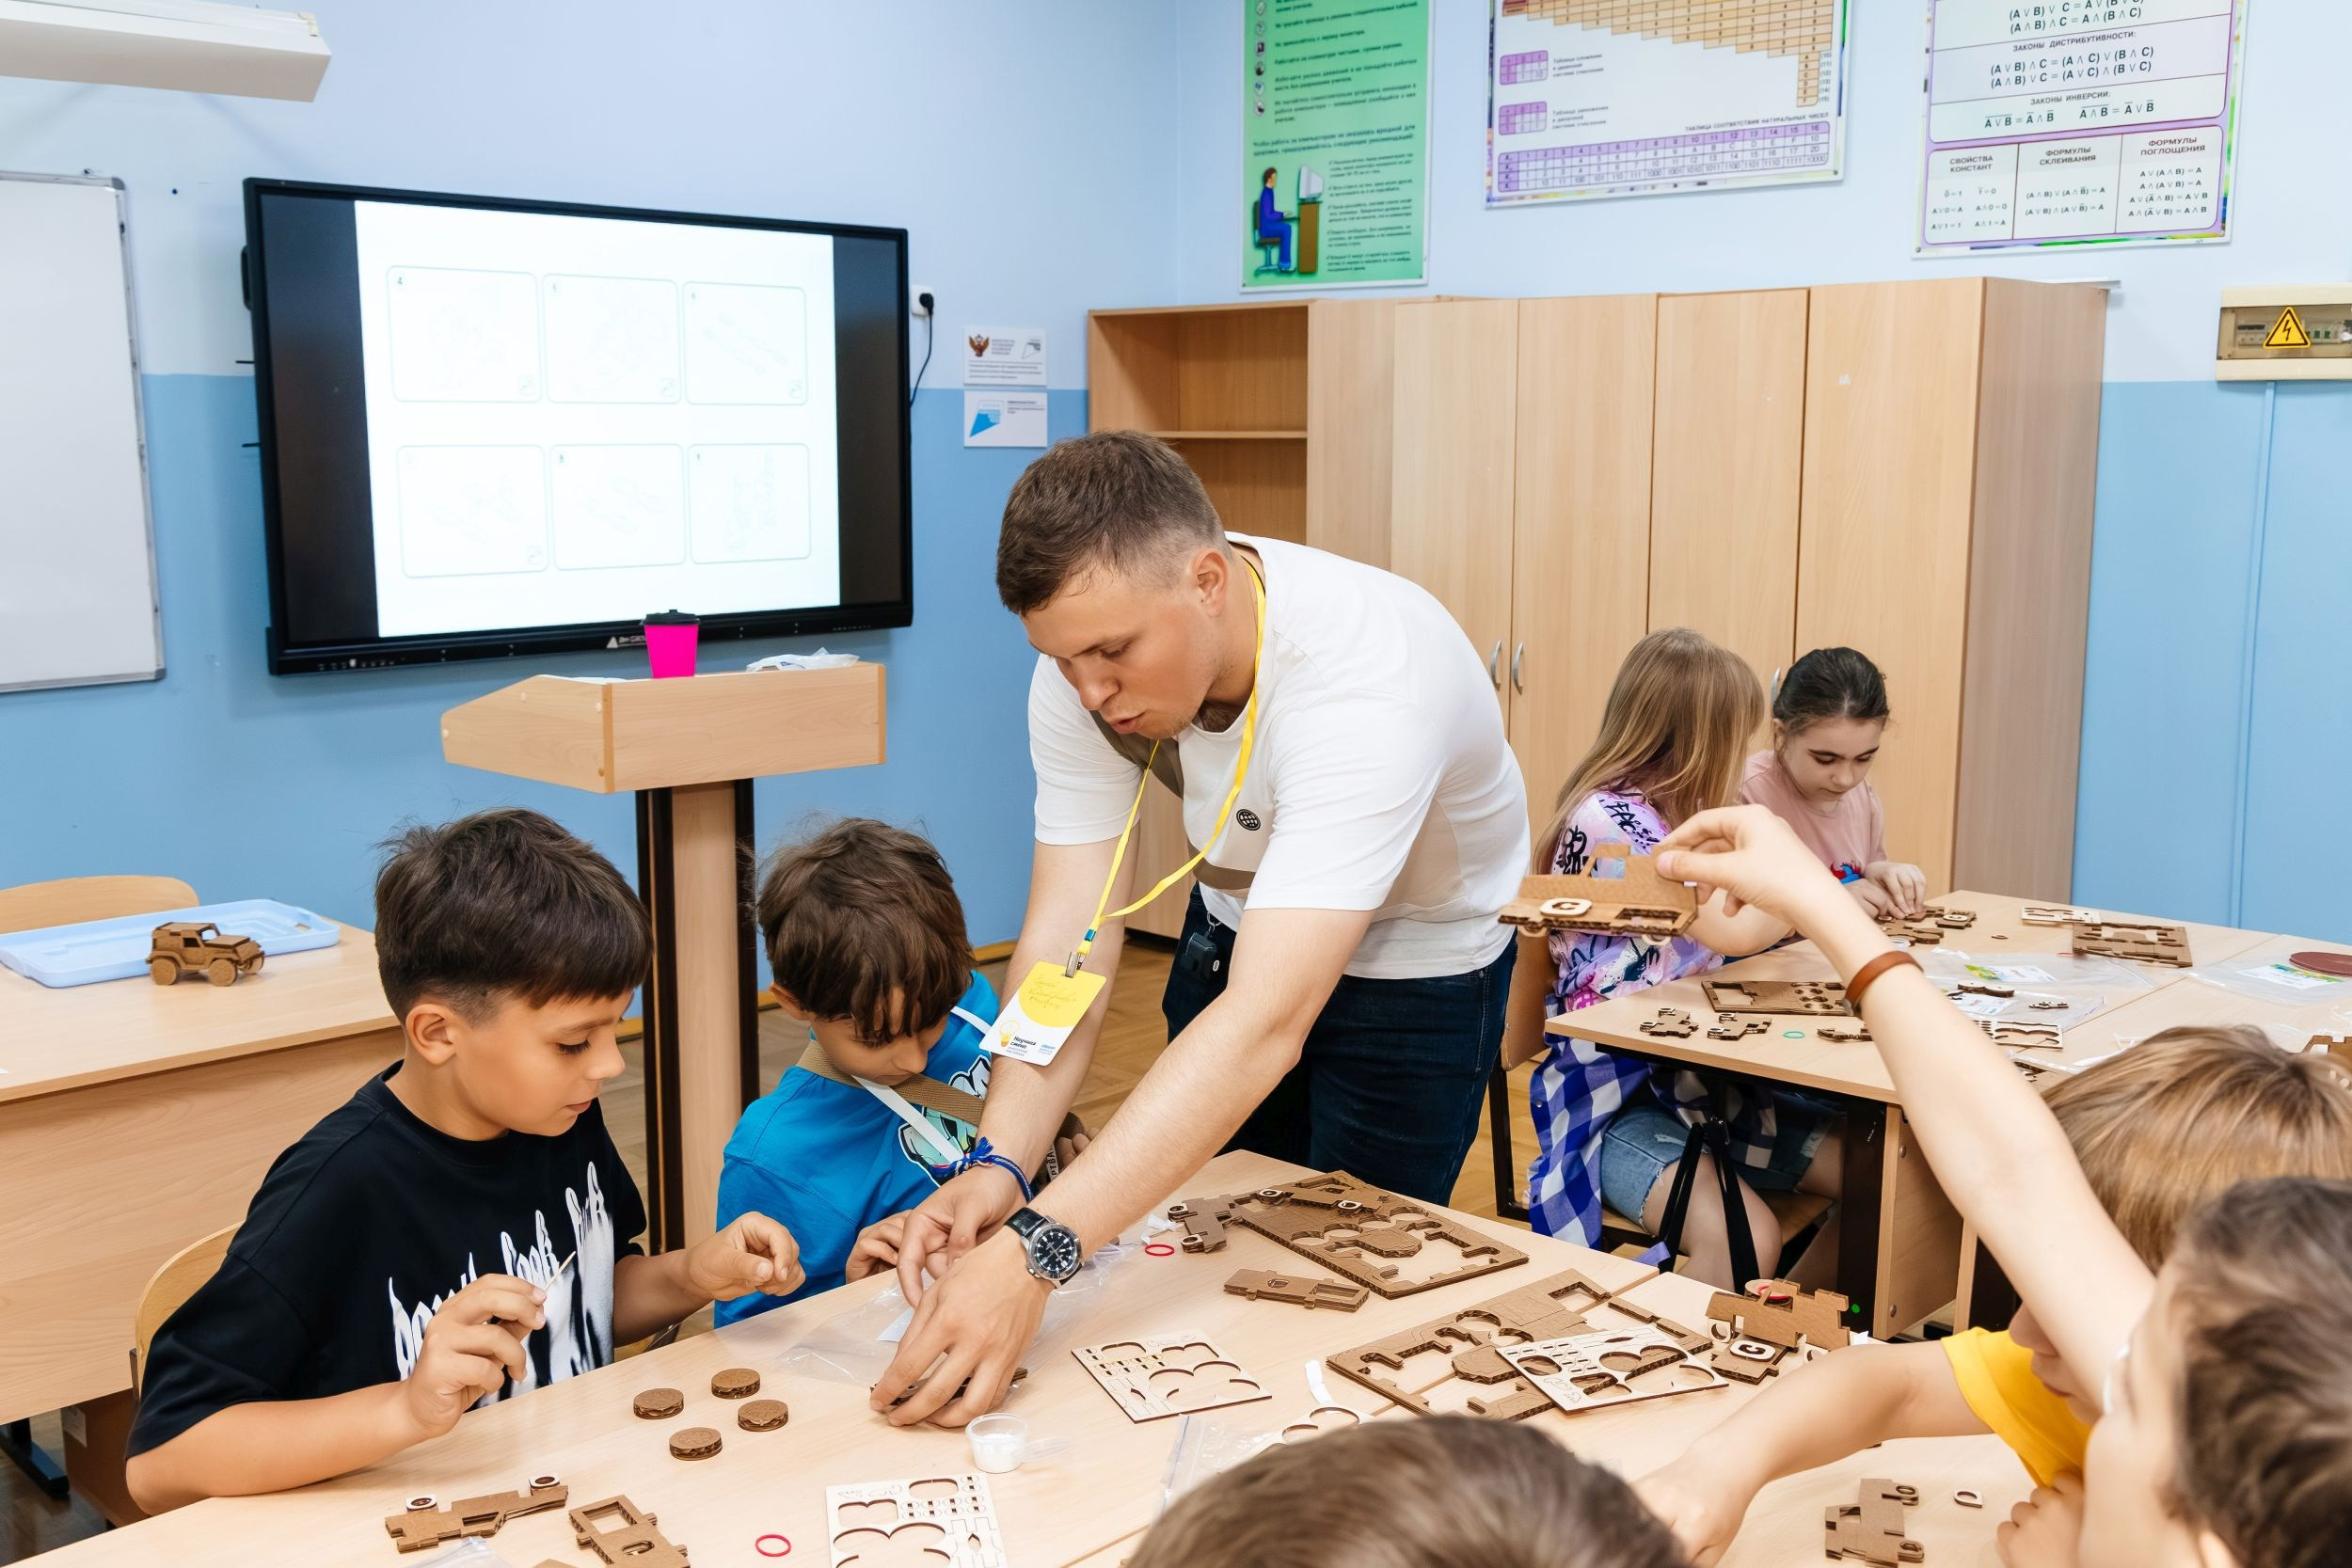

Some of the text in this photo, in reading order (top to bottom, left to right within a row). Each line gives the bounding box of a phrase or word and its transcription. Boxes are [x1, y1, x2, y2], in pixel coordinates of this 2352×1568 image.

[2013, 31, 2136, 52] ЗАКОНЫ ДИСТРИБУТИВНОСТИ:
[2031, 97, 2062, 105] ЗАКОНЫ
[2149, 137, 2197, 146] ФОРМУЛЫ
[2046, 147, 2091, 156] ФОРМУЛЫ
[2141, 145, 2205, 156] ПОГЛОЩЕНИЯ
[1950, 155, 1993, 165] СВОЙСТВА
[2039, 155, 2096, 165] СКЛЕИВАНИЯ
[1950, 164, 1992, 172] КОНСТАНТ
